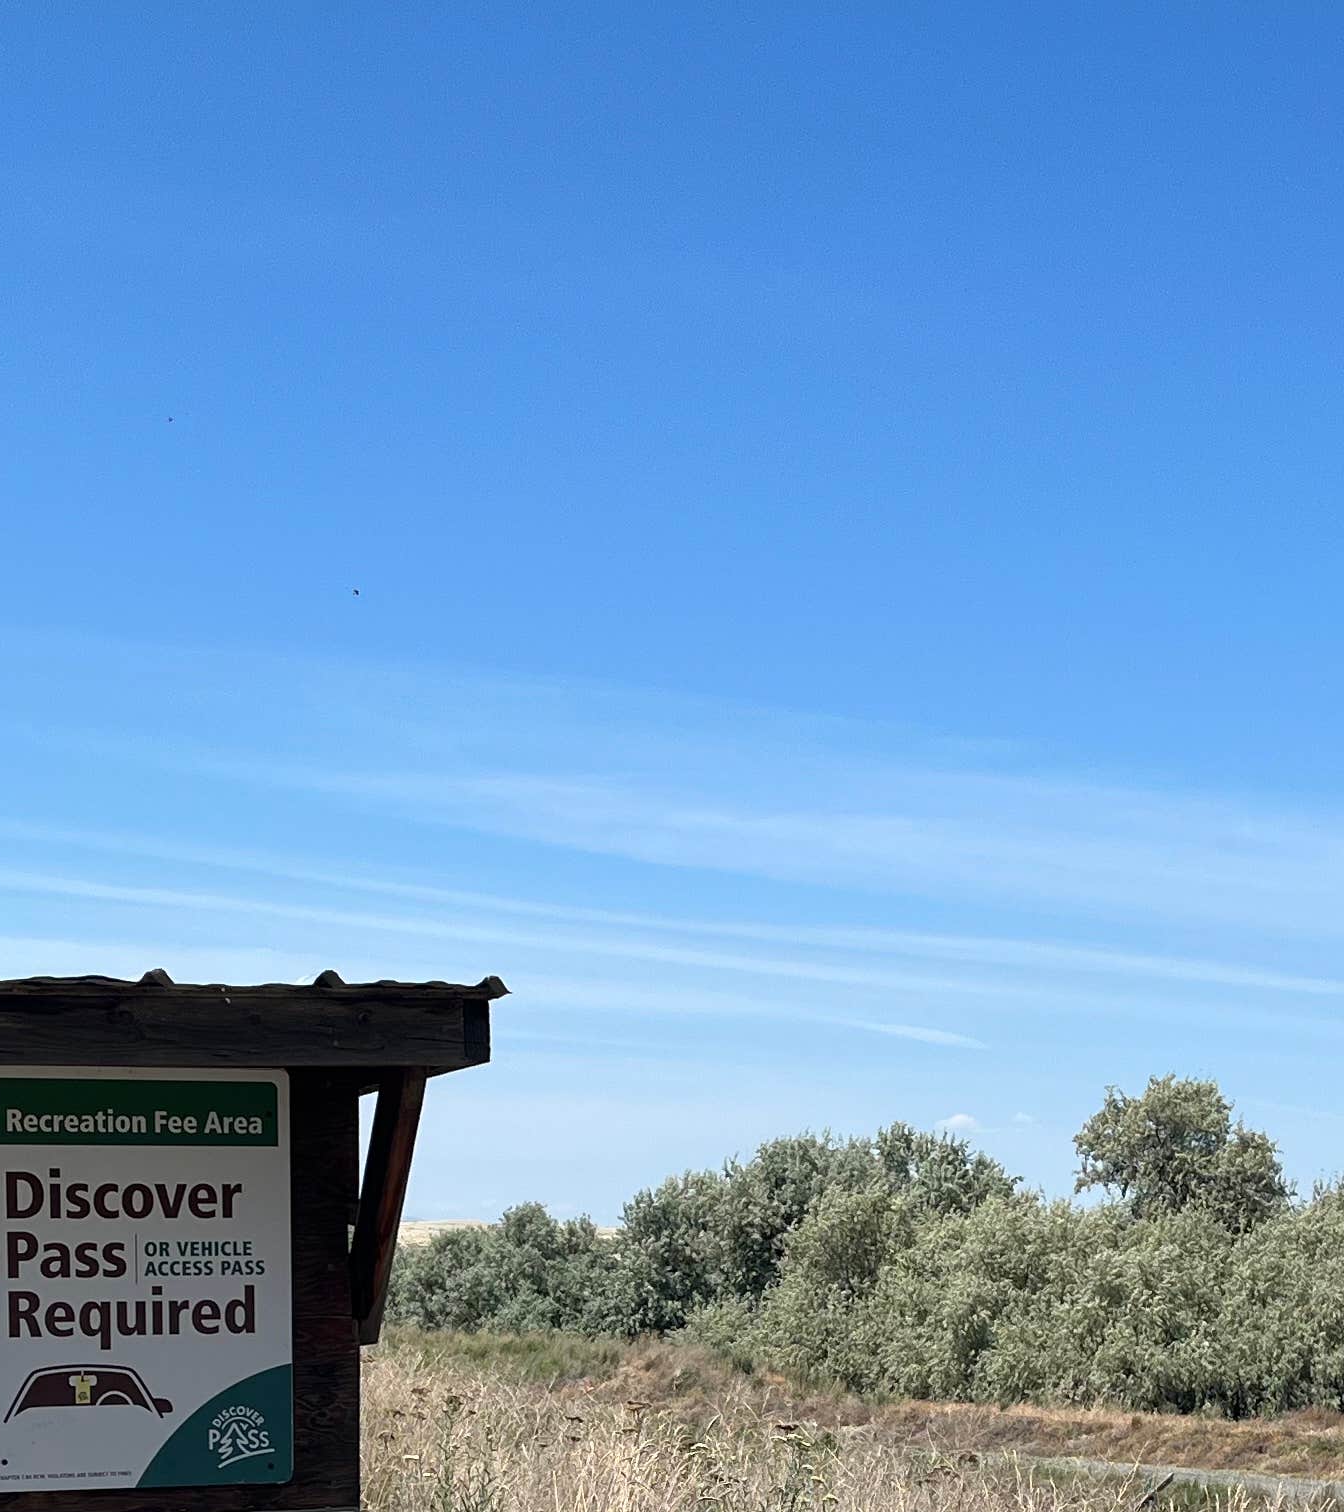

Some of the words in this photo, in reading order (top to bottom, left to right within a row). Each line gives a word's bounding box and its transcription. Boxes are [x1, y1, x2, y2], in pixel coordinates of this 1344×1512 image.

[5, 1107, 147, 1135] Recreation
[153, 1109, 199, 1135] Fee
[204, 1110, 264, 1135] Area
[5, 1168, 242, 1220] Discover
[6, 1231, 128, 1280] Pass
[143, 1240, 171, 1258] OR
[177, 1239, 253, 1258] VEHICLE
[143, 1260, 214, 1277] ACCESS
[220, 1259, 266, 1277] PASS
[6, 1284, 257, 1351] Required
[212, 1405, 266, 1429] DISCOVER
